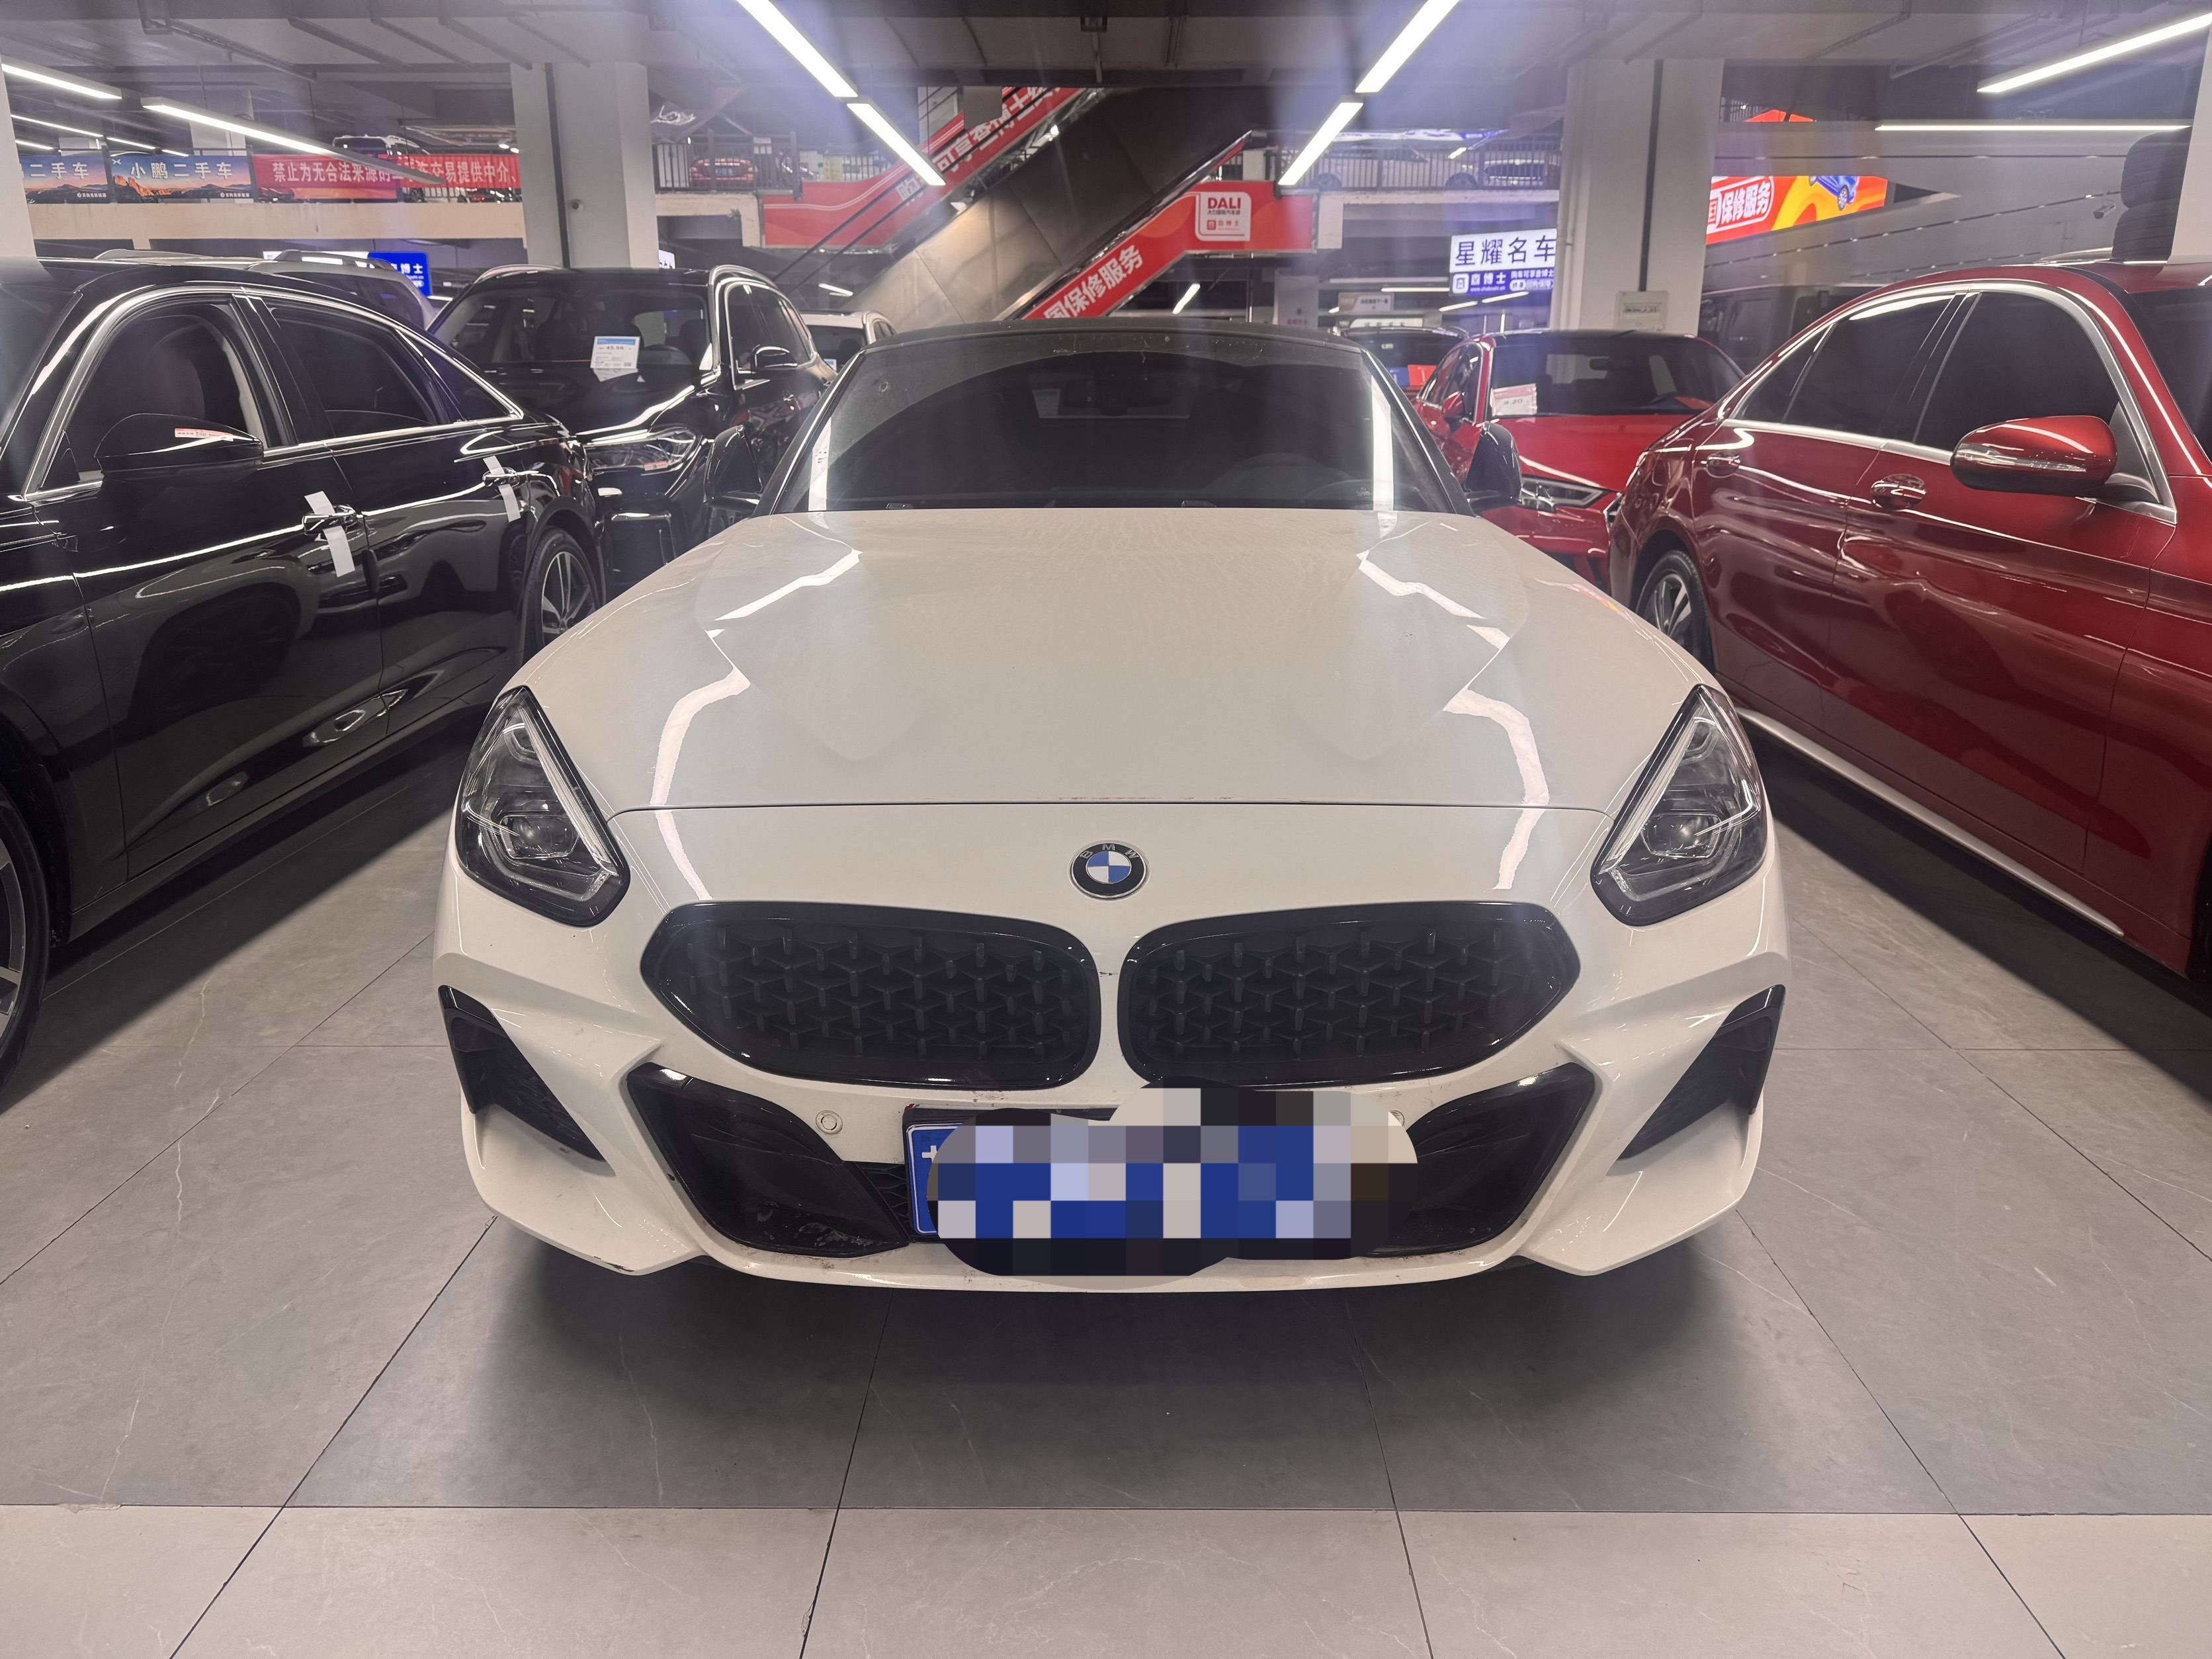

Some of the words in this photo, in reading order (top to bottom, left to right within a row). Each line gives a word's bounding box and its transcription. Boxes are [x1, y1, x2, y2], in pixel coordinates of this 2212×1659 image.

[21, 162, 89, 179] 二手车
[131, 162, 232, 179] 小鹏二手车
[1208, 197, 1241, 209] DALI
[1455, 235, 1556, 266] 星耀名车
[1080, 843, 1139, 859] BMW
